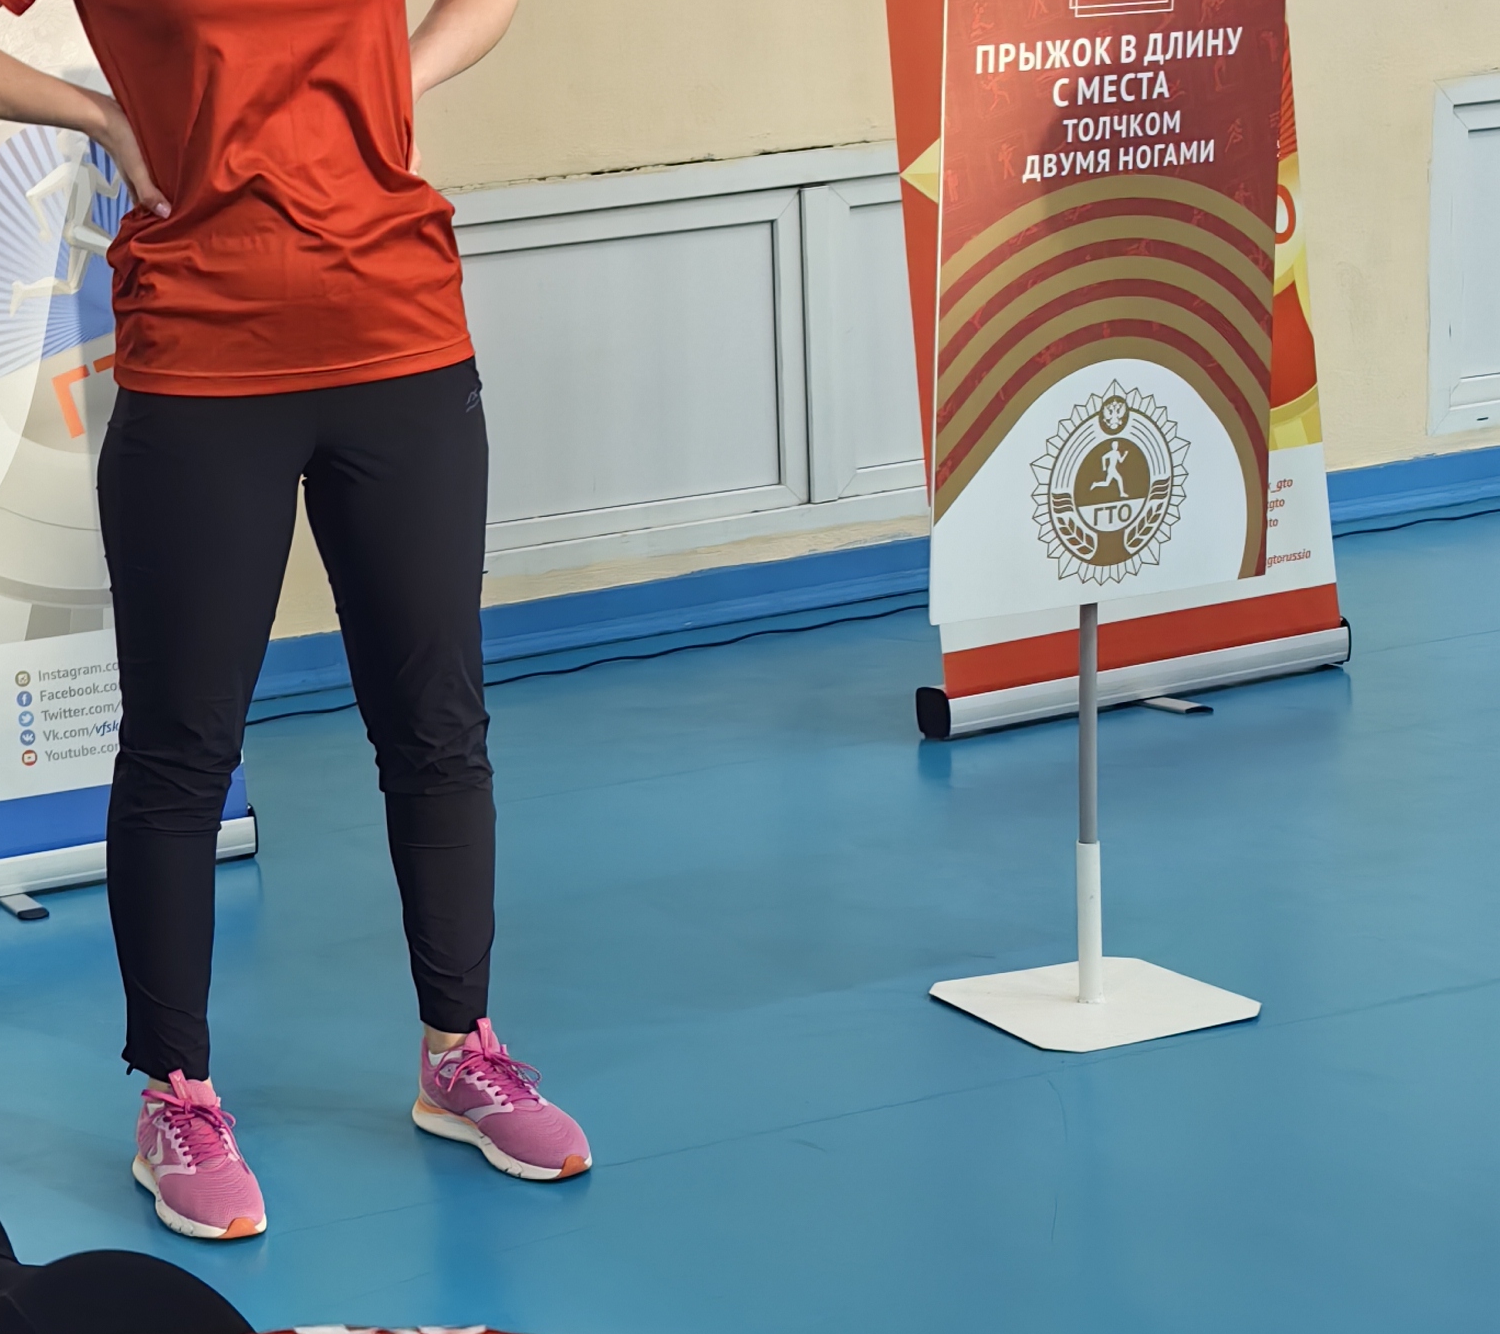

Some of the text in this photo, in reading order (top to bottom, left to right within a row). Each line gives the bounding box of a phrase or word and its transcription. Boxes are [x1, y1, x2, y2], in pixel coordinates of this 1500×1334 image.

[975, 26, 1244, 75] ПРЫЖОК В ДЛИНУ
[1053, 70, 1171, 108] С МЕСТА
[1062, 110, 1182, 144] ТОЛЧКОМ
[1022, 139, 1216, 184] ДВУМЯ НОГАМИ
[1093, 503, 1132, 527] ГТО
[1268, 498, 1286, 512] gto
[39, 682, 119, 703] Facebook.co
[40, 699, 121, 723] Twitter.com/
[44, 743, 118, 762] Youtube.co
